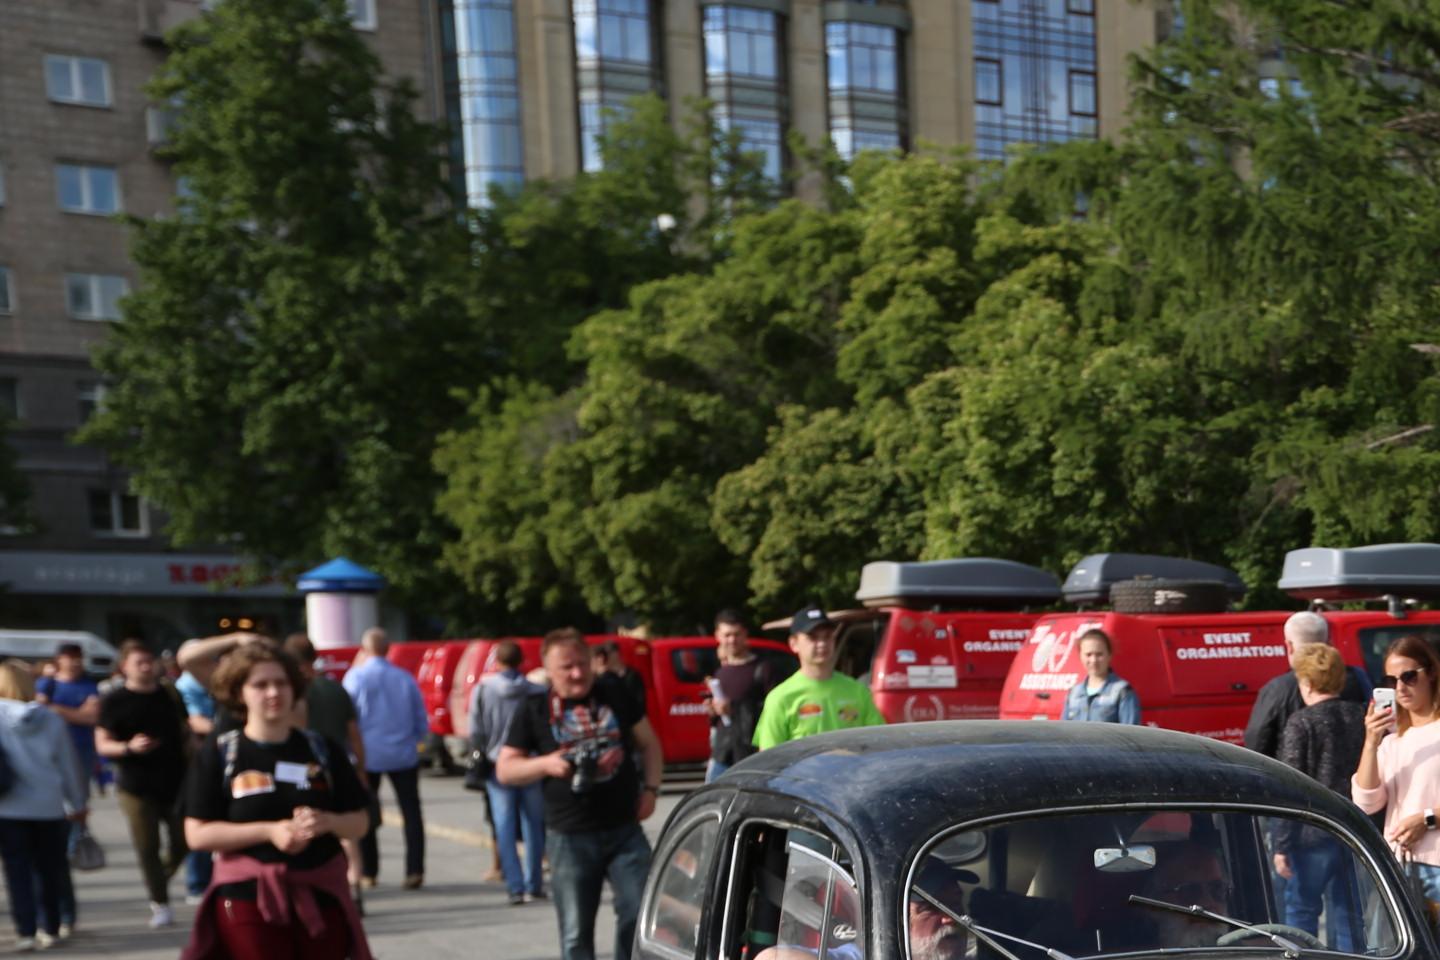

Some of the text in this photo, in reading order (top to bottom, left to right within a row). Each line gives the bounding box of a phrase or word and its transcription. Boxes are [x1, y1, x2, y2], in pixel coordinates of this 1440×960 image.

[989, 629, 1031, 640] EVENT
[1204, 632, 1251, 645] EVENT
[1176, 645, 1286, 660] ORGANISATION
